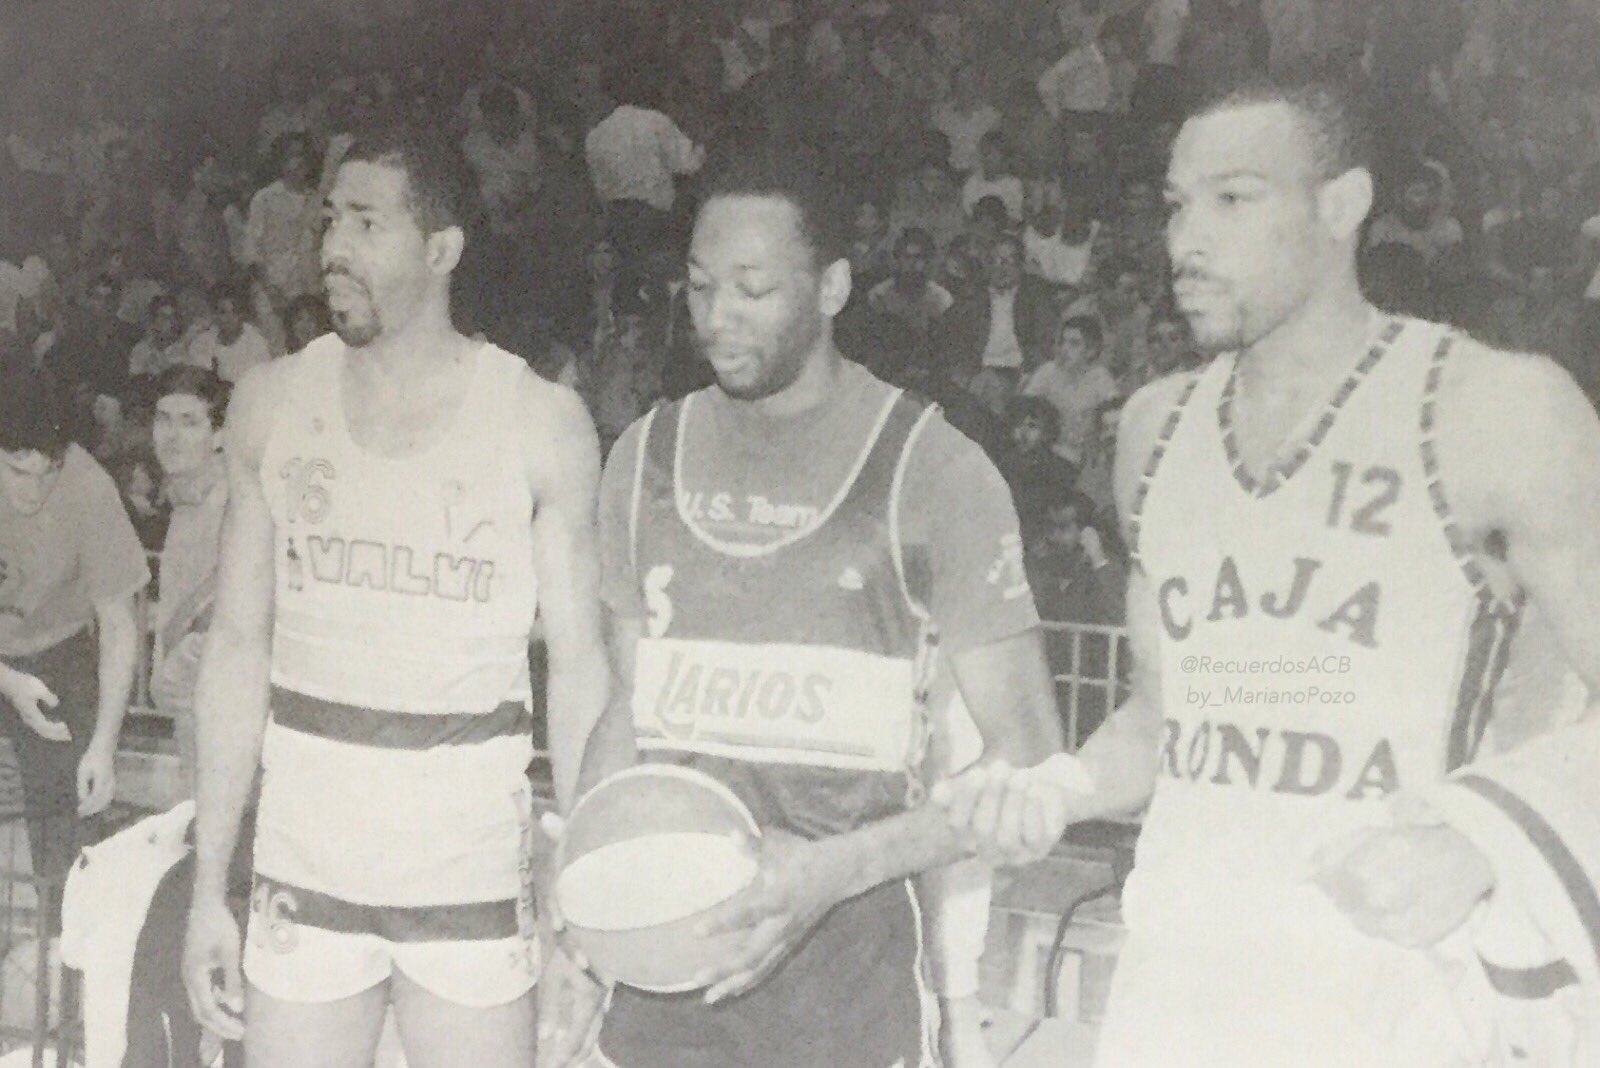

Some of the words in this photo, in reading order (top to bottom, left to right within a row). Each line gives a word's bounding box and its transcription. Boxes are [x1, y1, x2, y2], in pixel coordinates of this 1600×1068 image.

[279, 455, 336, 525] 16
[1325, 458, 1404, 537] 12
[1158, 554, 1383, 651] CAJA
[653, 650, 834, 741] LARIOS
[1160, 717, 1402, 803] RONDA
